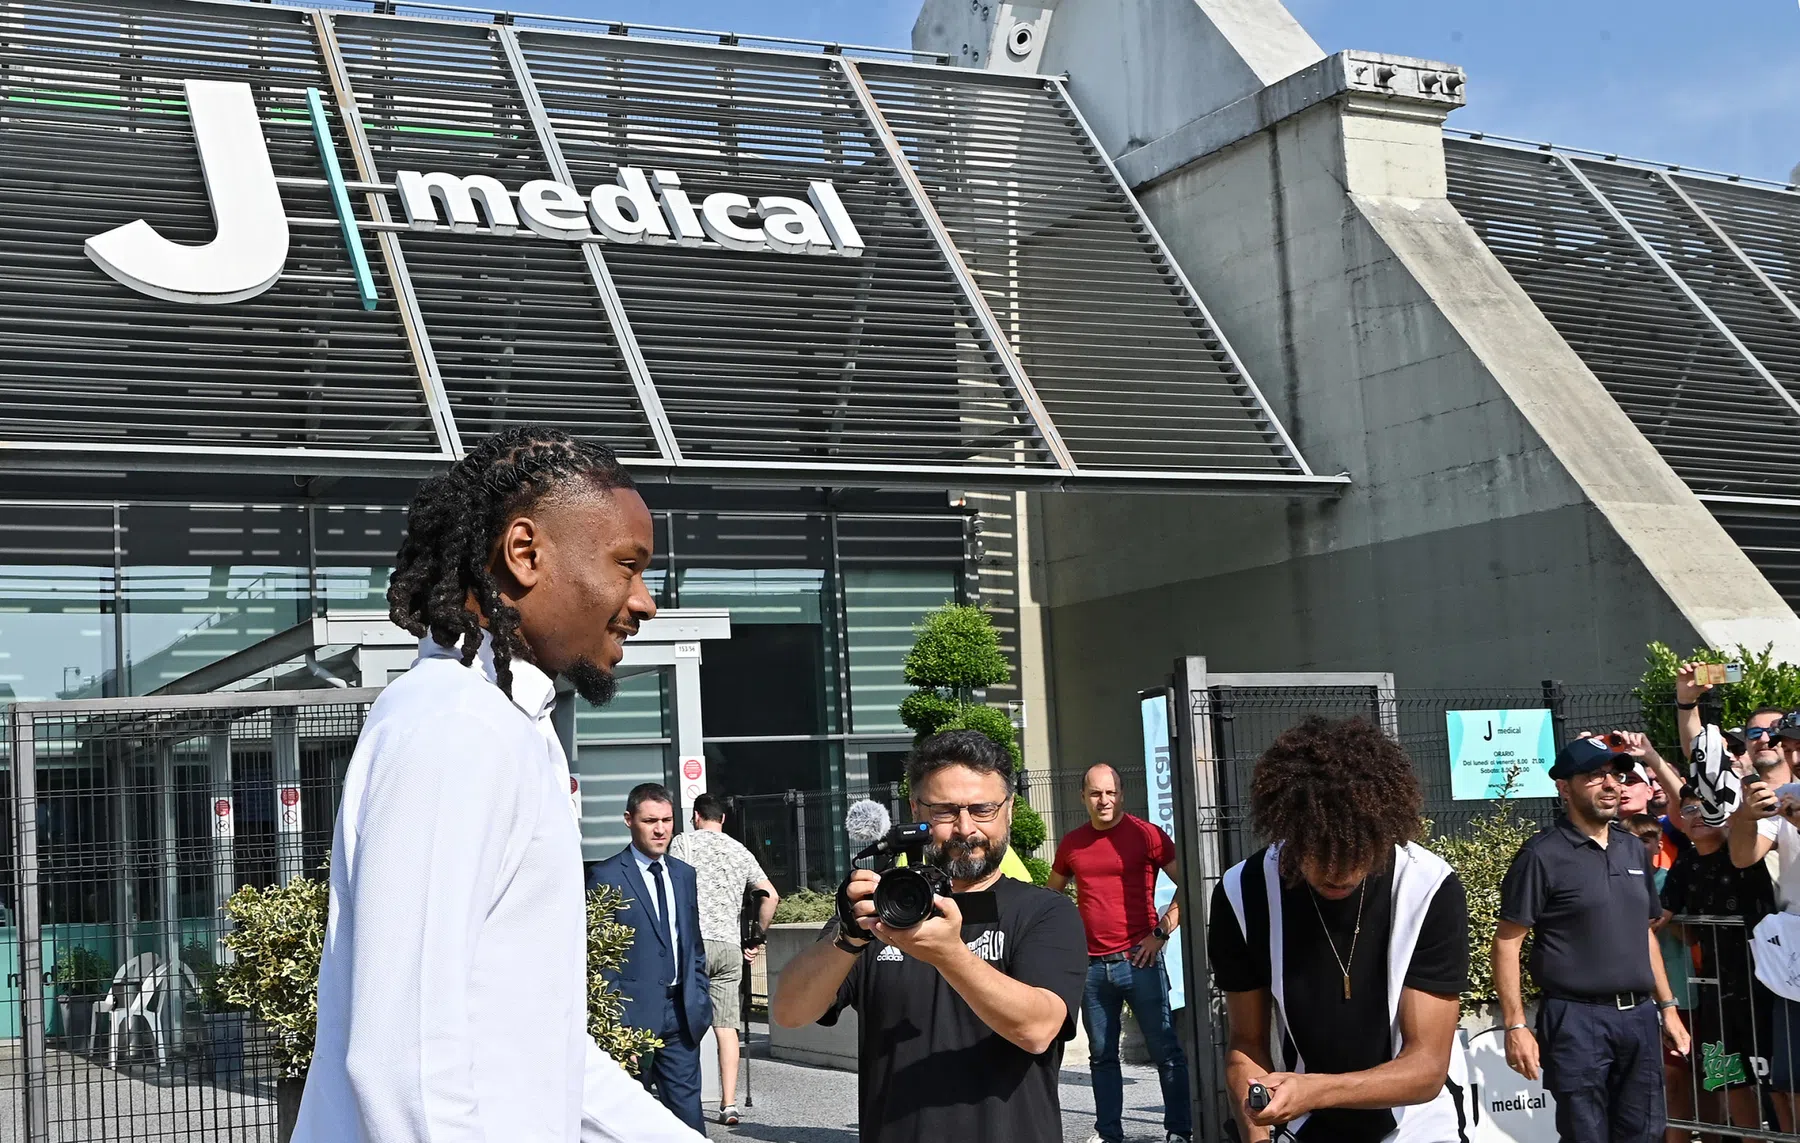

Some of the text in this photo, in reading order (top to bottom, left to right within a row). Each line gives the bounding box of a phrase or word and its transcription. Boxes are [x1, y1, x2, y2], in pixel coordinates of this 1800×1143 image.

[84, 79, 864, 304] J medical
[1483, 720, 1522, 741] J medical
[1492, 1093, 1546, 1112] medical
